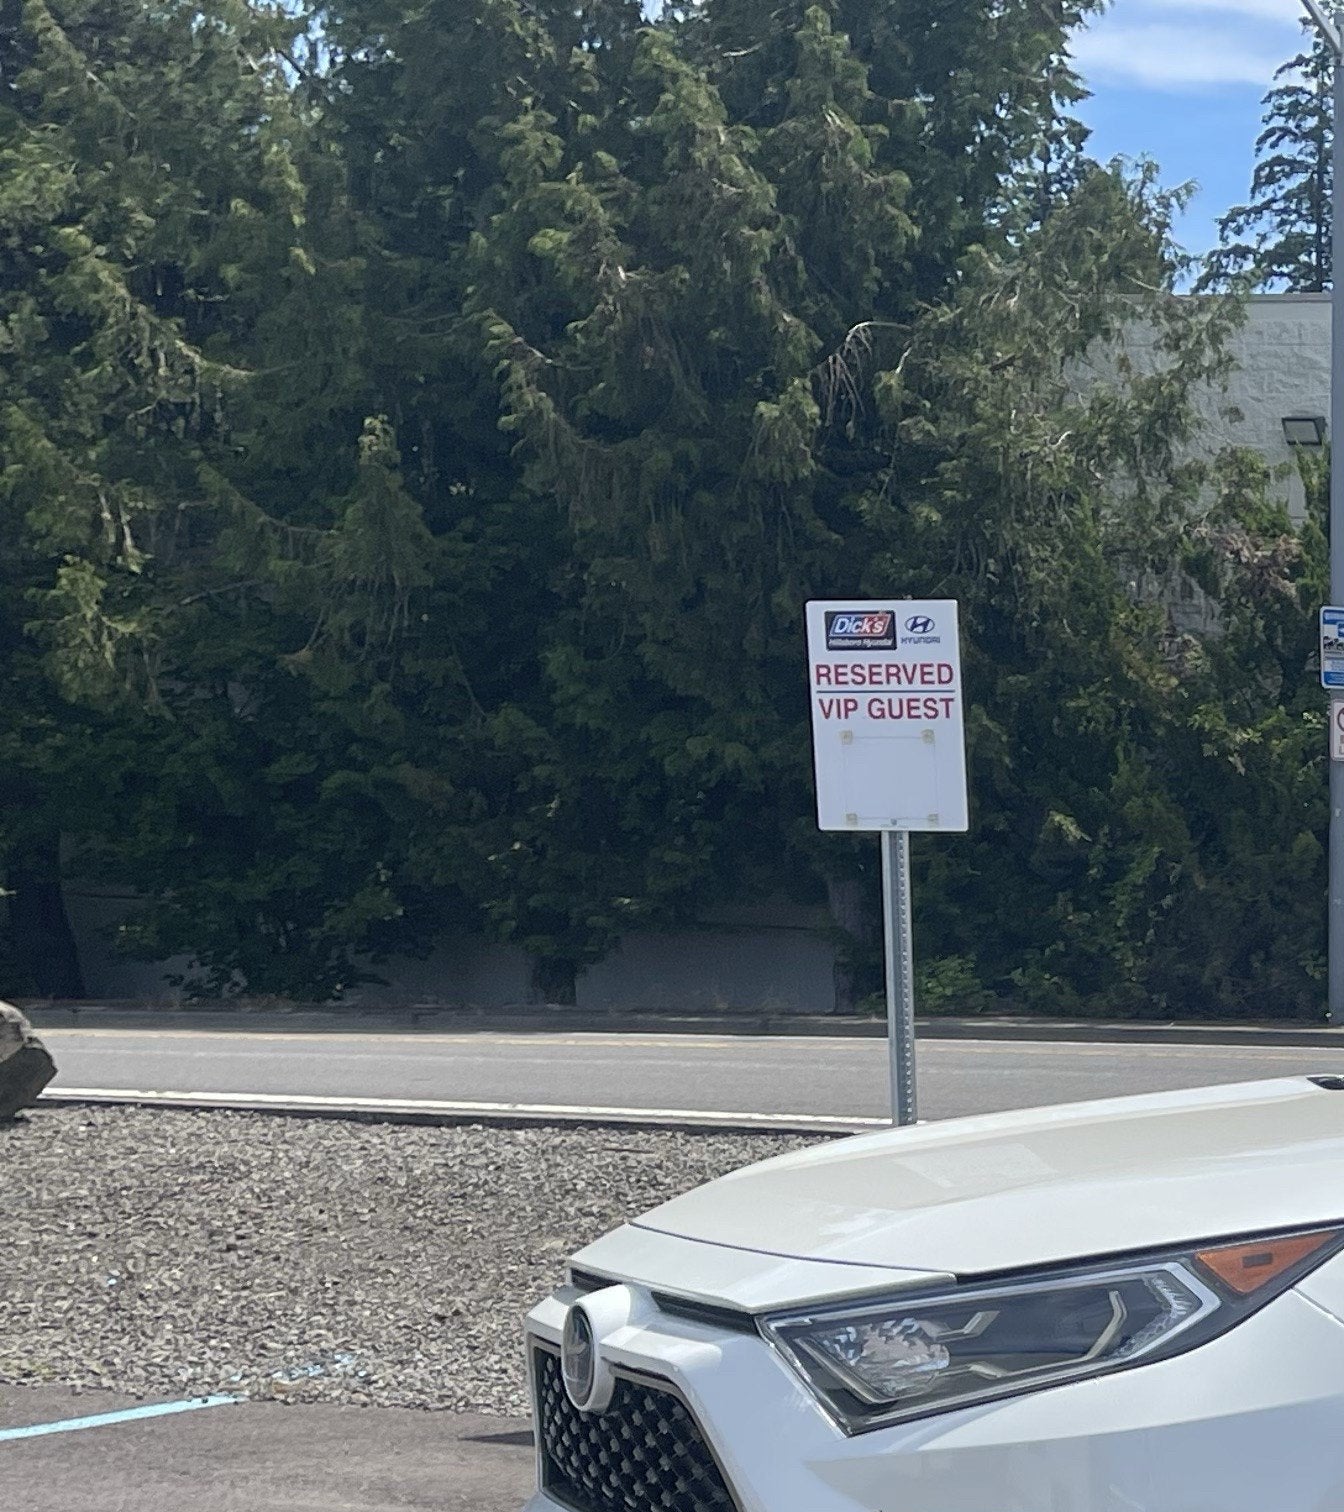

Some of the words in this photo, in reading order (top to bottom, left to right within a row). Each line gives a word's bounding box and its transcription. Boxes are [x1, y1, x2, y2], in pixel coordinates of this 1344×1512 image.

[815, 663, 954, 686] RESERVED
[818, 698, 859, 720] VIP
[867, 698, 956, 720] GUEST
